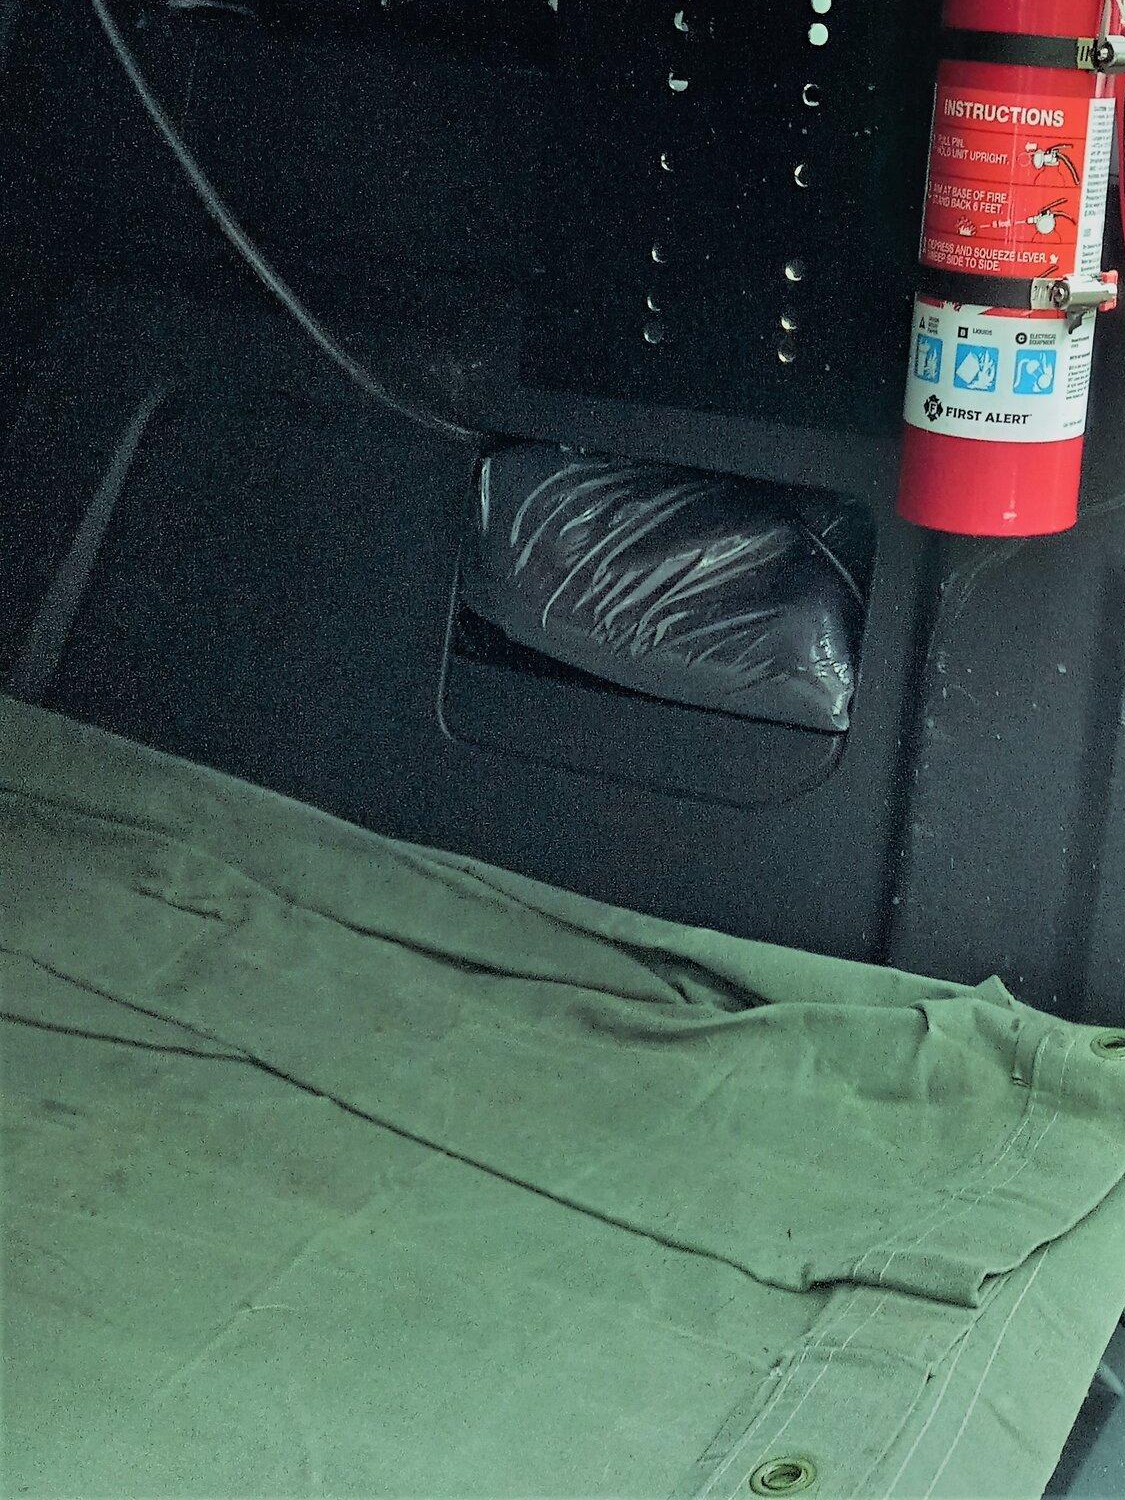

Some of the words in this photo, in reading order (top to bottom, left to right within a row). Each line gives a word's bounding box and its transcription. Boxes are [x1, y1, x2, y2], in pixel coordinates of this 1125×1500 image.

[944, 99, 1065, 128] INSTRUCTIONS
[970, 150, 1010, 165] UPRIGHT.
[951, 187, 972, 200] BASE
[972, 190, 985, 201] OF
[950, 197, 971, 210] BACK
[979, 202, 1004, 215] FEET.
[955, 244, 973, 257] AND
[973, 247, 1016, 260] SQUEEZE
[1017, 251, 1047, 263] LEVER.
[964, 256, 977, 268] TO
[946, 406, 982, 422] FIRST
